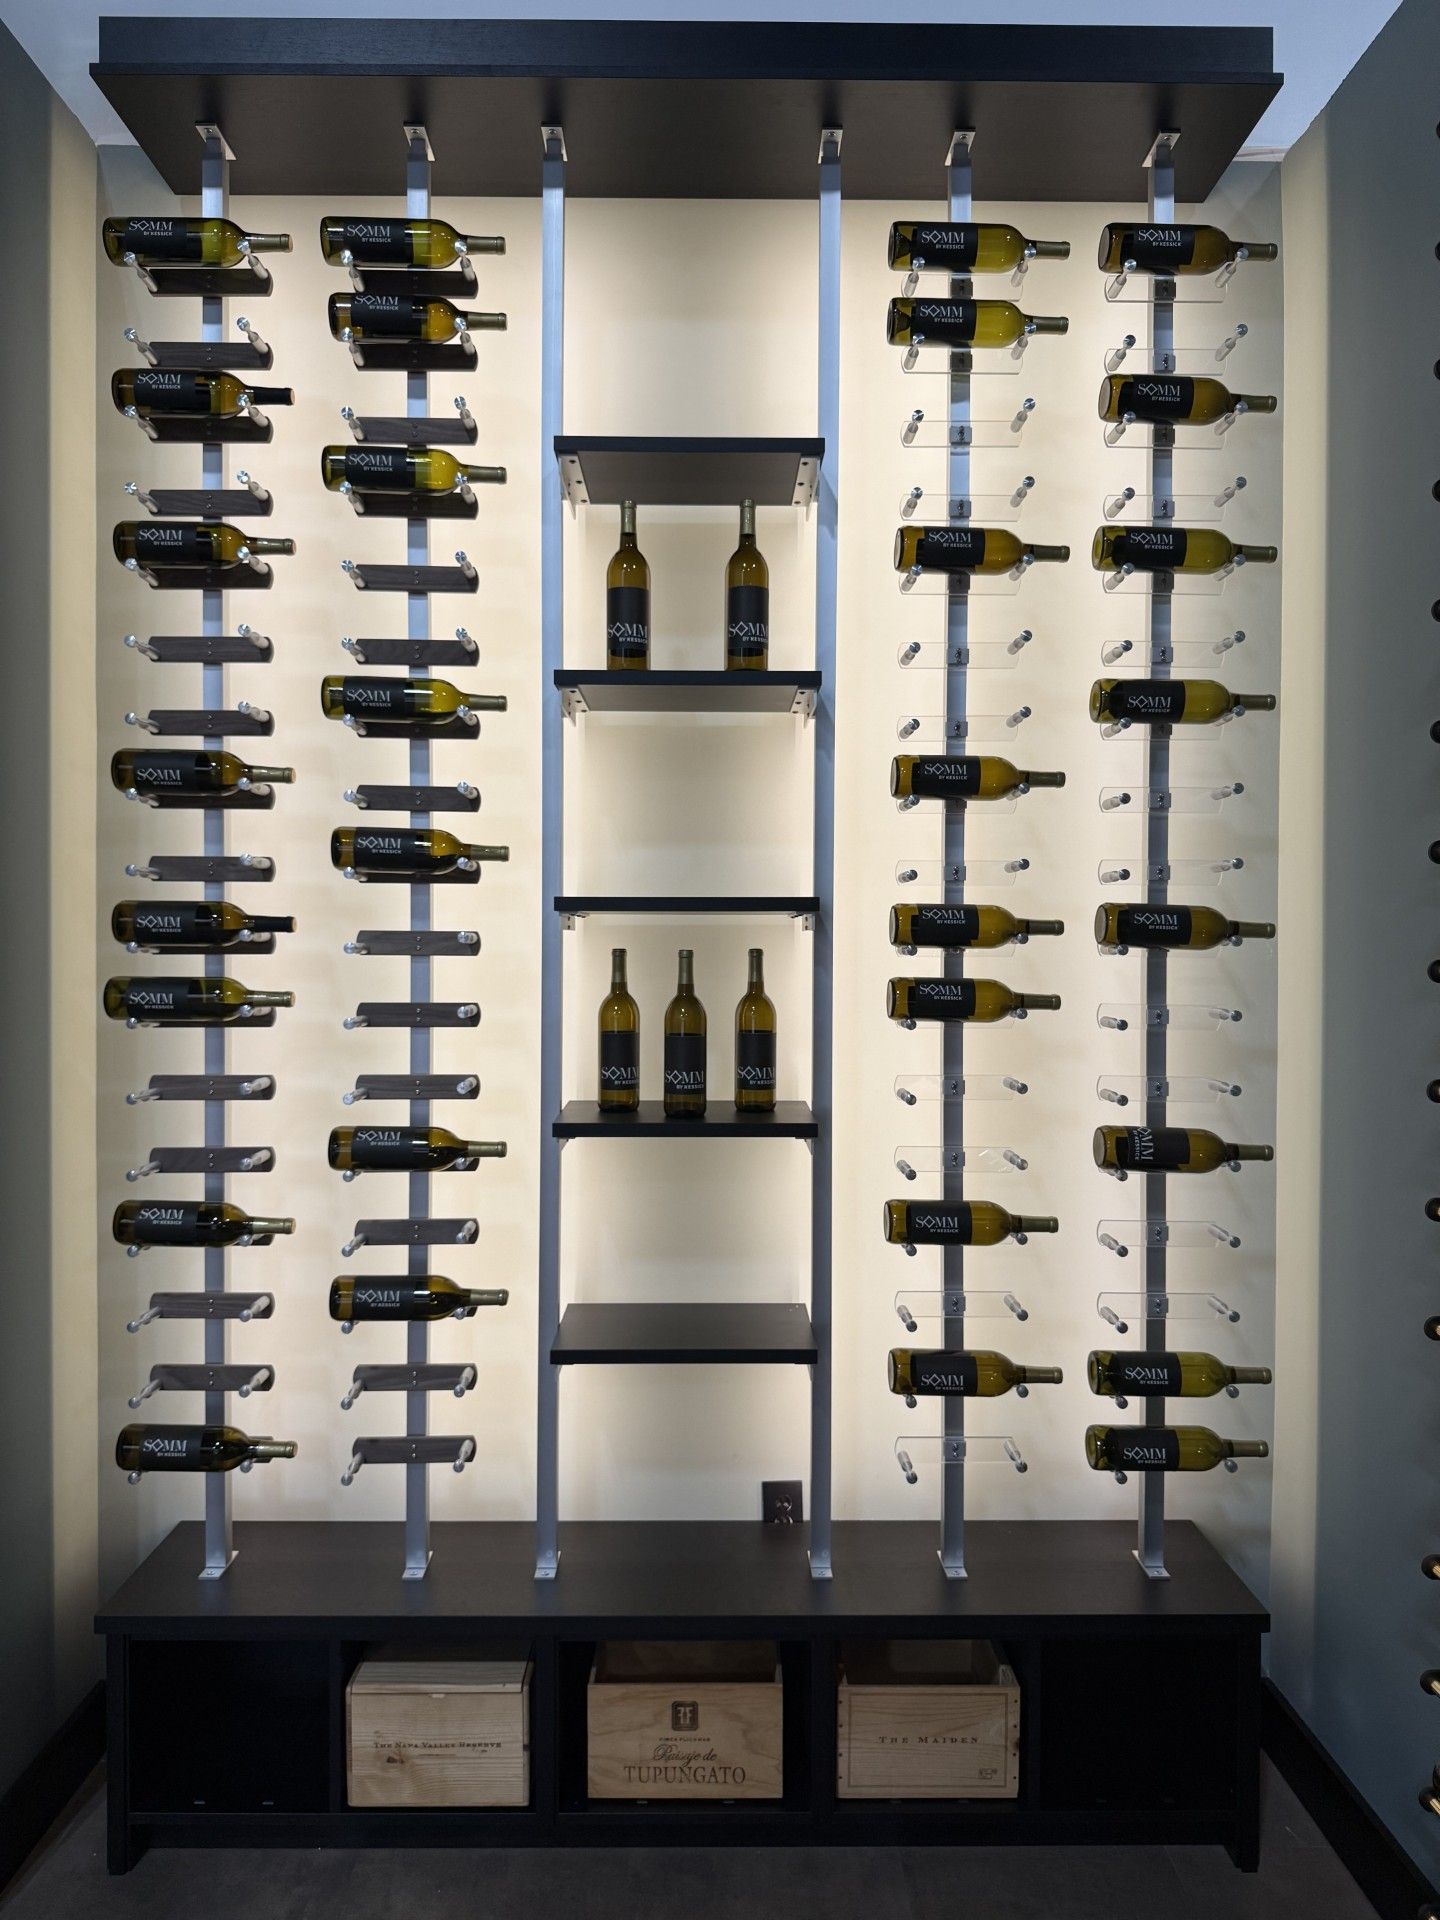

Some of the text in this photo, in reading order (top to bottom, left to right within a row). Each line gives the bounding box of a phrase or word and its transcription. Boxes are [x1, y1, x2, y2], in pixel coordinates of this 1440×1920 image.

[129, 220, 172, 231] SOMM
[347, 224, 390, 237] SOMM
[922, 230, 964, 243] SOMM
[1139, 229, 1181, 241] SOMM
[355, 295, 398, 305] SOMM
[920, 305, 962, 317] SOMM
[138, 373, 181, 384] SOMM
[1138, 384, 1180, 396] SOMM
[348, 454, 392, 465] SOMM
[139, 528, 182, 540] SOMM
[929, 531, 971, 542] SOMM
[1130, 533, 1173, 544] SOMM
[347, 689, 390, 701] SOMM
[1128, 696, 1170, 708] SOMM
[137, 768, 181, 780] SOMM
[925, 763, 966, 774] SOMM
[357, 837, 401, 848] SOMM
[922, 909, 965, 920] SOMM
[1134, 913, 1177, 924] SOMM
[137, 916, 180, 928] SOMM
[920, 984, 962, 995] SOMM
[129, 992, 173, 1004] SOMM
[357, 1131, 400, 1141] SOMM
[1137, 1126, 1154, 1160] OMM
[139, 1208, 183, 1220] SOMM
[916, 1216, 958, 1228] SOMM
[357, 1290, 400, 1302] SOMM
[1126, 1367, 1168, 1379] SOMM
[921, 1374, 963, 1386] SOMM
[143, 1438, 187, 1451] SOMM
[1124, 1447, 1166, 1460] SOMM
[702, 1747, 718, 1762] de
[624, 1766, 746, 1784] TUPUNGATO
